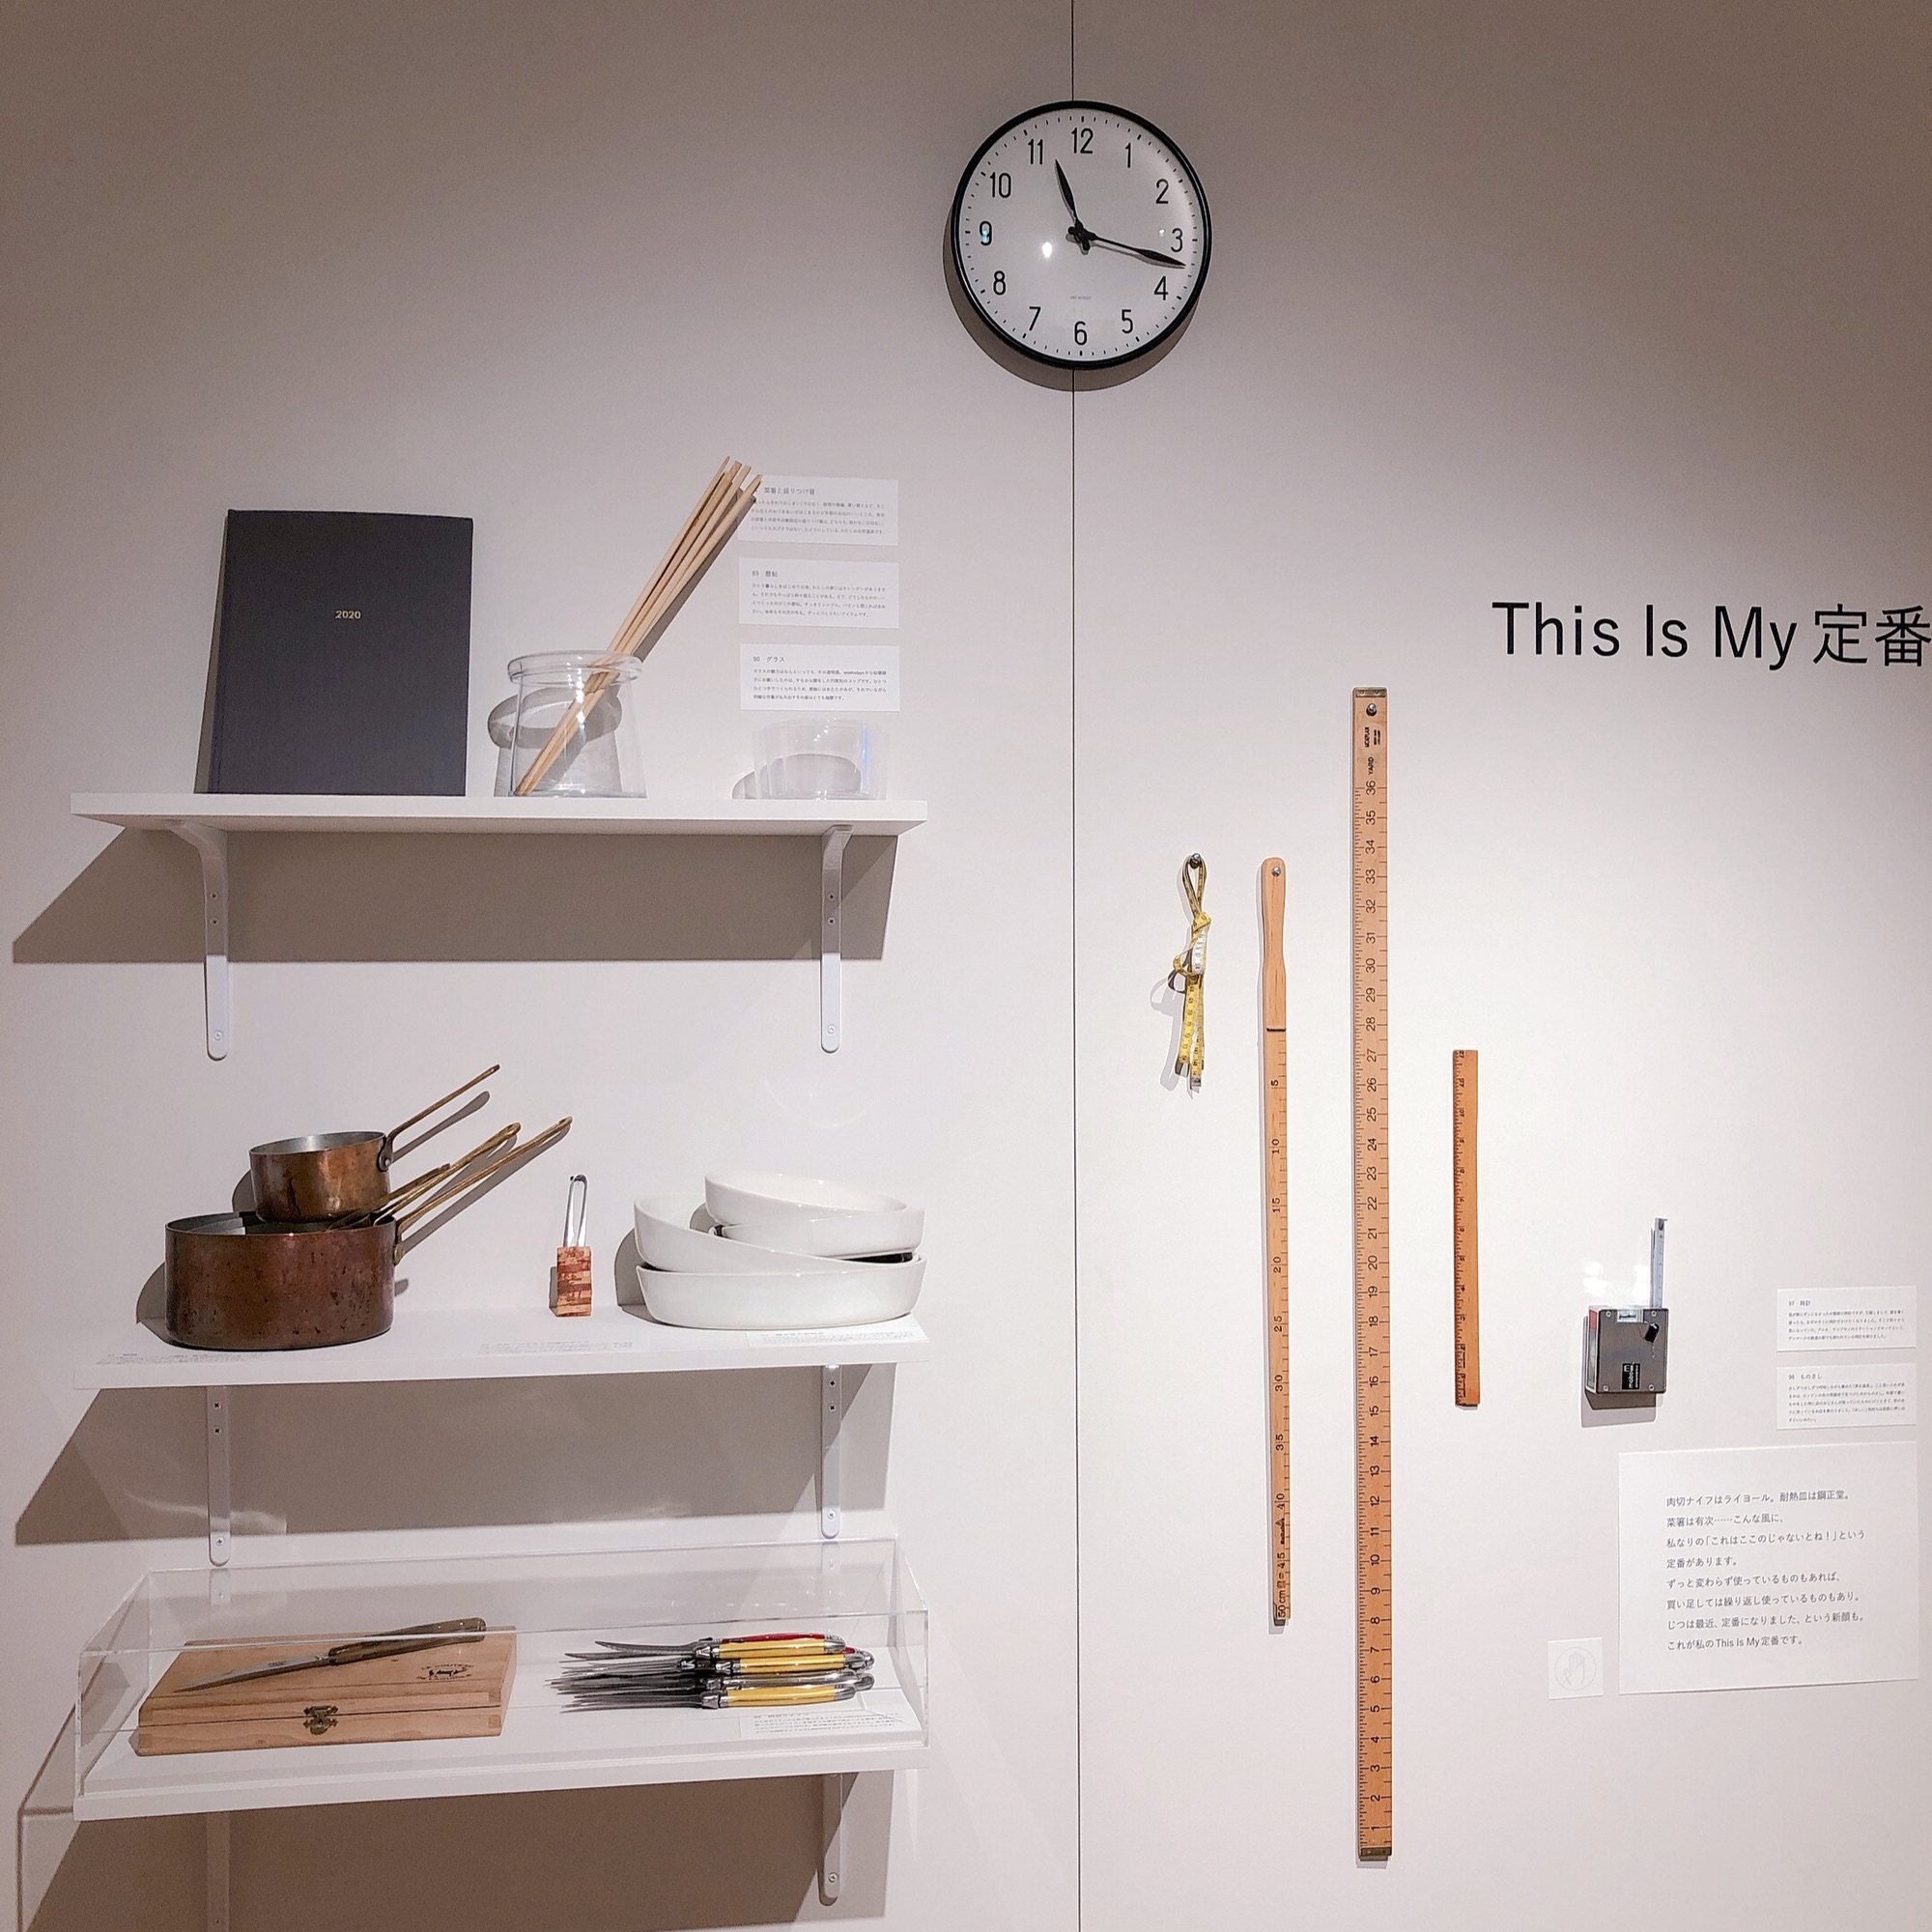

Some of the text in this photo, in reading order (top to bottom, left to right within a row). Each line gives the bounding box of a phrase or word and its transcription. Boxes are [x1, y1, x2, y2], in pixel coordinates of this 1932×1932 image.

[1070, 127, 1094, 155] 12
[1027, 137, 1044, 166] 11
[1124, 141, 1132, 169] 1
[989, 171, 1012, 199] 10
[1154, 178, 1170, 205] 2
[979, 219, 993, 247] 9
[1170, 227, 1183, 253] 3
[992, 270, 1007, 297] 8
[1153, 274, 1169, 301] 4
[1028, 305, 1042, 332] 7
[1121, 308, 1134, 335] 5
[1073, 320, 1088, 347] 6
[336, 610, 361, 619] 2020
[1492, 602, 1932, 670] This Is My 定番
[1366, 780, 1377, 796] 36
[1366, 810, 1377, 826] 35
[1366, 839, 1377, 855] 34
[1366, 868, 1377, 885] 33
[1366, 898, 1377, 914] 32
[1367, 931, 1378, 945] 31
[1367, 957, 1378, 974] 30
[1367, 987, 1378, 1003] 29
[1367, 1016, 1378, 1032] 28
[1367, 1049, 1378, 1063] 27
[1368, 1077, 1378, 1093] 26
[1368, 1107, 1378, 1122] 25
[1271, 1138, 1280, 1154] 10
[1368, 1138, 1378, 1151] 24
[1368, 1166, 1378, 1181] 23
[1272, 1197, 1281, 1213] 15
[1368, 1196, 1378, 1211] 22
[1369, 1227, 1379, 1240] 21
[1273, 1256, 1282, 1273] 20
[1369, 1255, 1379, 1270] 20
[1369, 1285, 1379, 1297] 19
[1274, 1315, 1283, 1332] 25
[1369, 1315, 1379, 1327] 18
[1369, 1346, 1379, 1357] 17
[1275, 1375, 1283, 1392] 30
[1370, 1376, 1380, 1387] 16
[1370, 1405, 1380, 1416] 15
[1276, 1434, 1284, 1451] 35
[1370, 1435, 1380, 1448] 14
[1370, 1464, 1380, 1477] 13
[1276, 1492, 1285, 1510] 40
[1370, 1495, 1380, 1507] 12
[1370, 1526, 1380, 1537] 11
[1277, 1551, 1286, 1569] 45
[1371, 1552, 1381, 1567] 10
[1666, 1556, 1737, 1569] 定番があります。
[1666, 1572, 1839, 1589] ずっと変わらず使っているものもあれば、
[1371, 1586, 1381, 1596] 9
[1666, 1591, 1860, 1610] 買い足しては繰り返し使っているものもあり。
[1371, 1616, 1381, 1625] 8
[1667, 1611, 1864, 1631] じつは最近、定番になりました、という新顔も。
[1736, 1637, 1744, 1646] Is
[1371, 1675, 1381, 1684] 6
[1372, 1764, 1382, 1773] 3
[1372, 1794, 1382, 1803] 2
